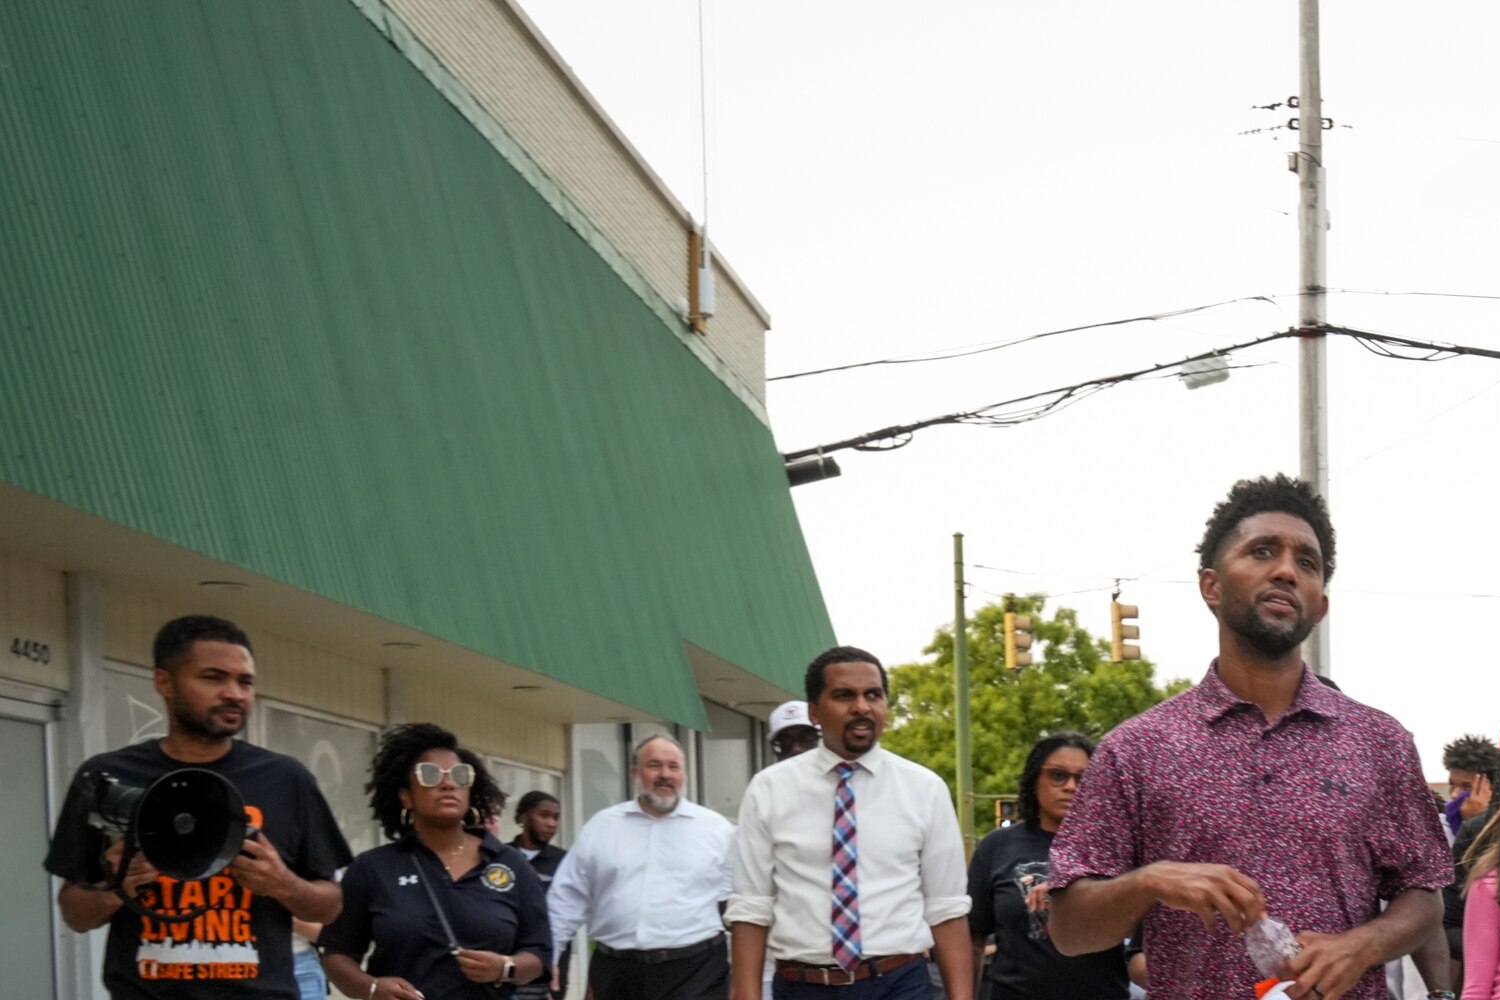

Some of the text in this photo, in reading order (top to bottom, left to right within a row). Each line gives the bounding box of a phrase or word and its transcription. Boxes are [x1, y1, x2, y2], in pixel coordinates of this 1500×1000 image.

[10, 637, 51, 666] 4450
[158, 961, 259, 979] SAFE STREETS
